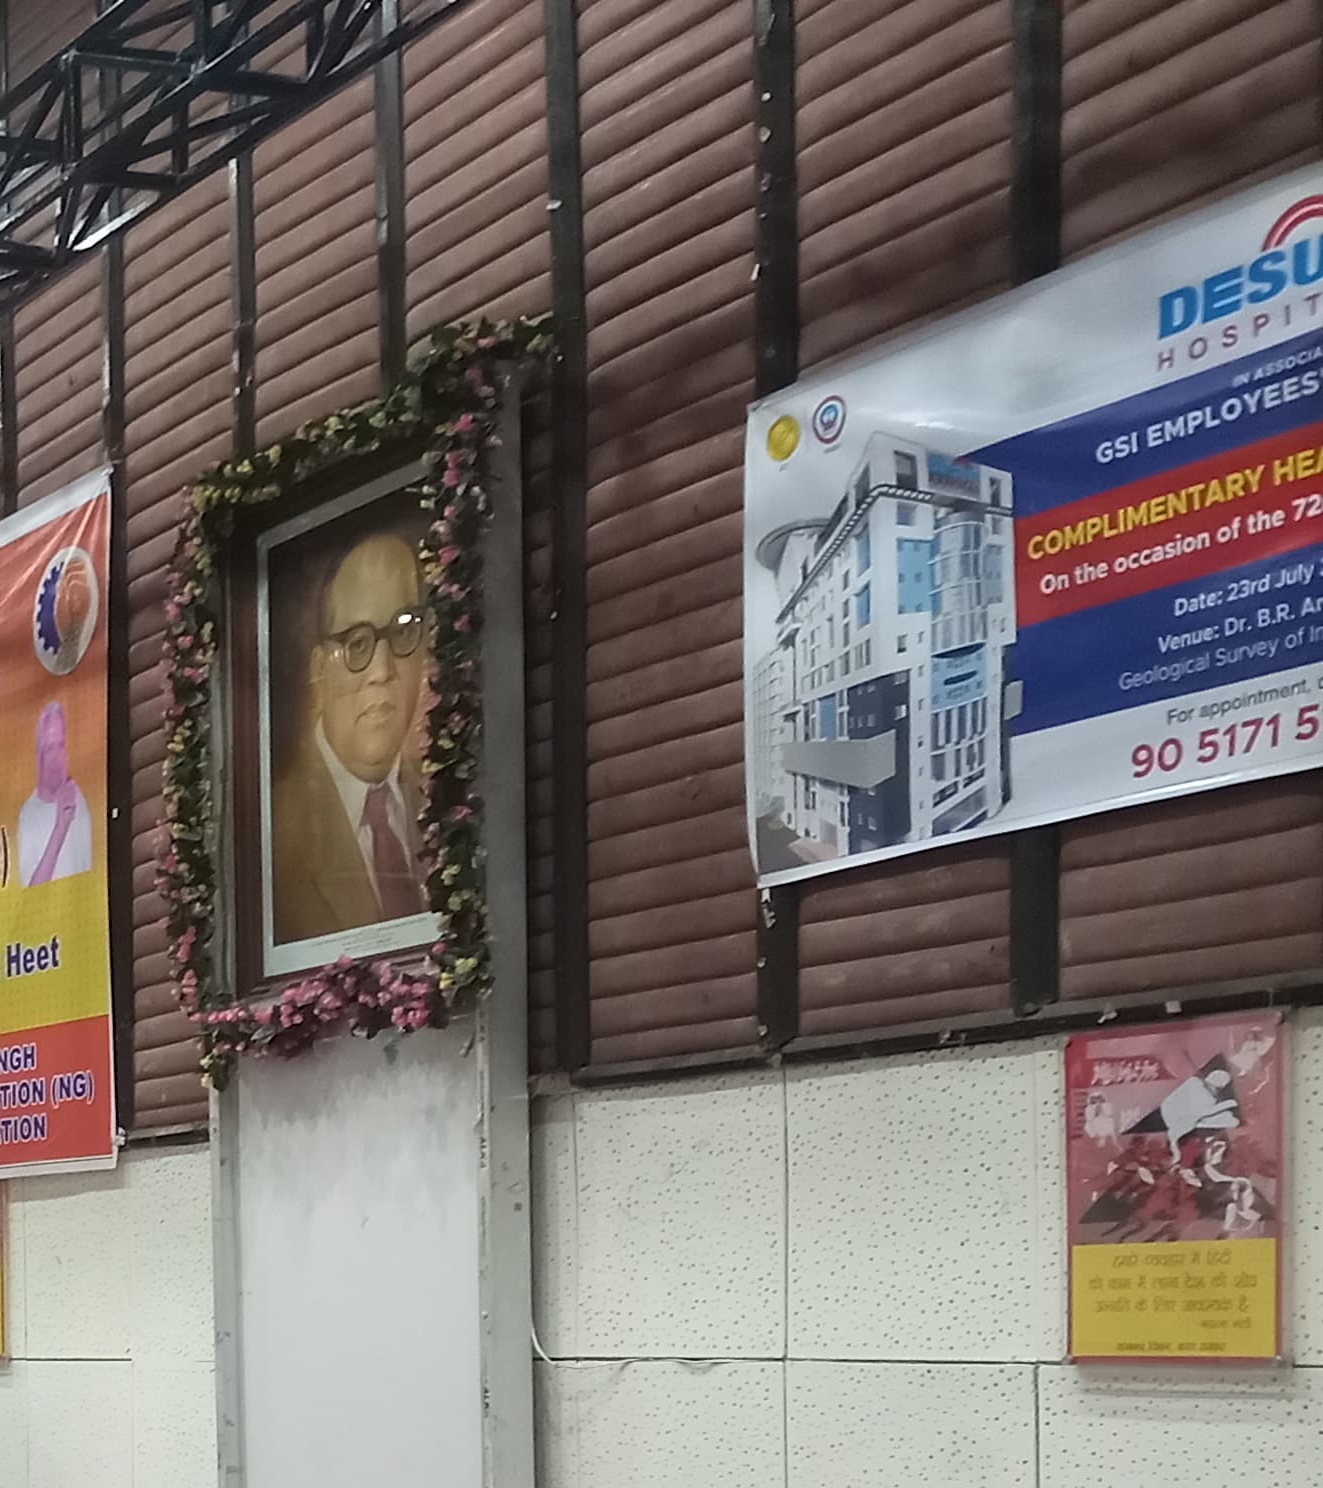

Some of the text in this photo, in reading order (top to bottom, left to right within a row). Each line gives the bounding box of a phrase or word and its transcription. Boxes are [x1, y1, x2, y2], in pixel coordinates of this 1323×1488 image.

[1158, 293, 1322, 371] HOSPIT
[1096, 435, 1140, 464] GSI
[1027, 464, 1266, 560] COMPLIMENTARY
[1040, 574, 1070, 594] On
[1074, 562, 1109, 585] the
[1113, 533, 1210, 573] occasion
[1216, 517, 1241, 543] of
[1247, 510, 1285, 535] the
[1174, 564, 1314, 617] Date: 23rd July
[1157, 626, 1220, 653] Venue:
[1224, 615, 1252, 638] Dr.
[1258, 603, 1295, 627] B.R.
[1119, 654, 1210, 690] Geological
[1215, 637, 1279, 666] Survey
[1285, 627, 1305, 648] of
[1167, 705, 1195, 725] For
[1132, 738, 1184, 778] 90
[1197, 713, 1281, 763] 5171
[6, 935, 60, 978] Heet
[51, 1071, 94, 1108] (NG)
